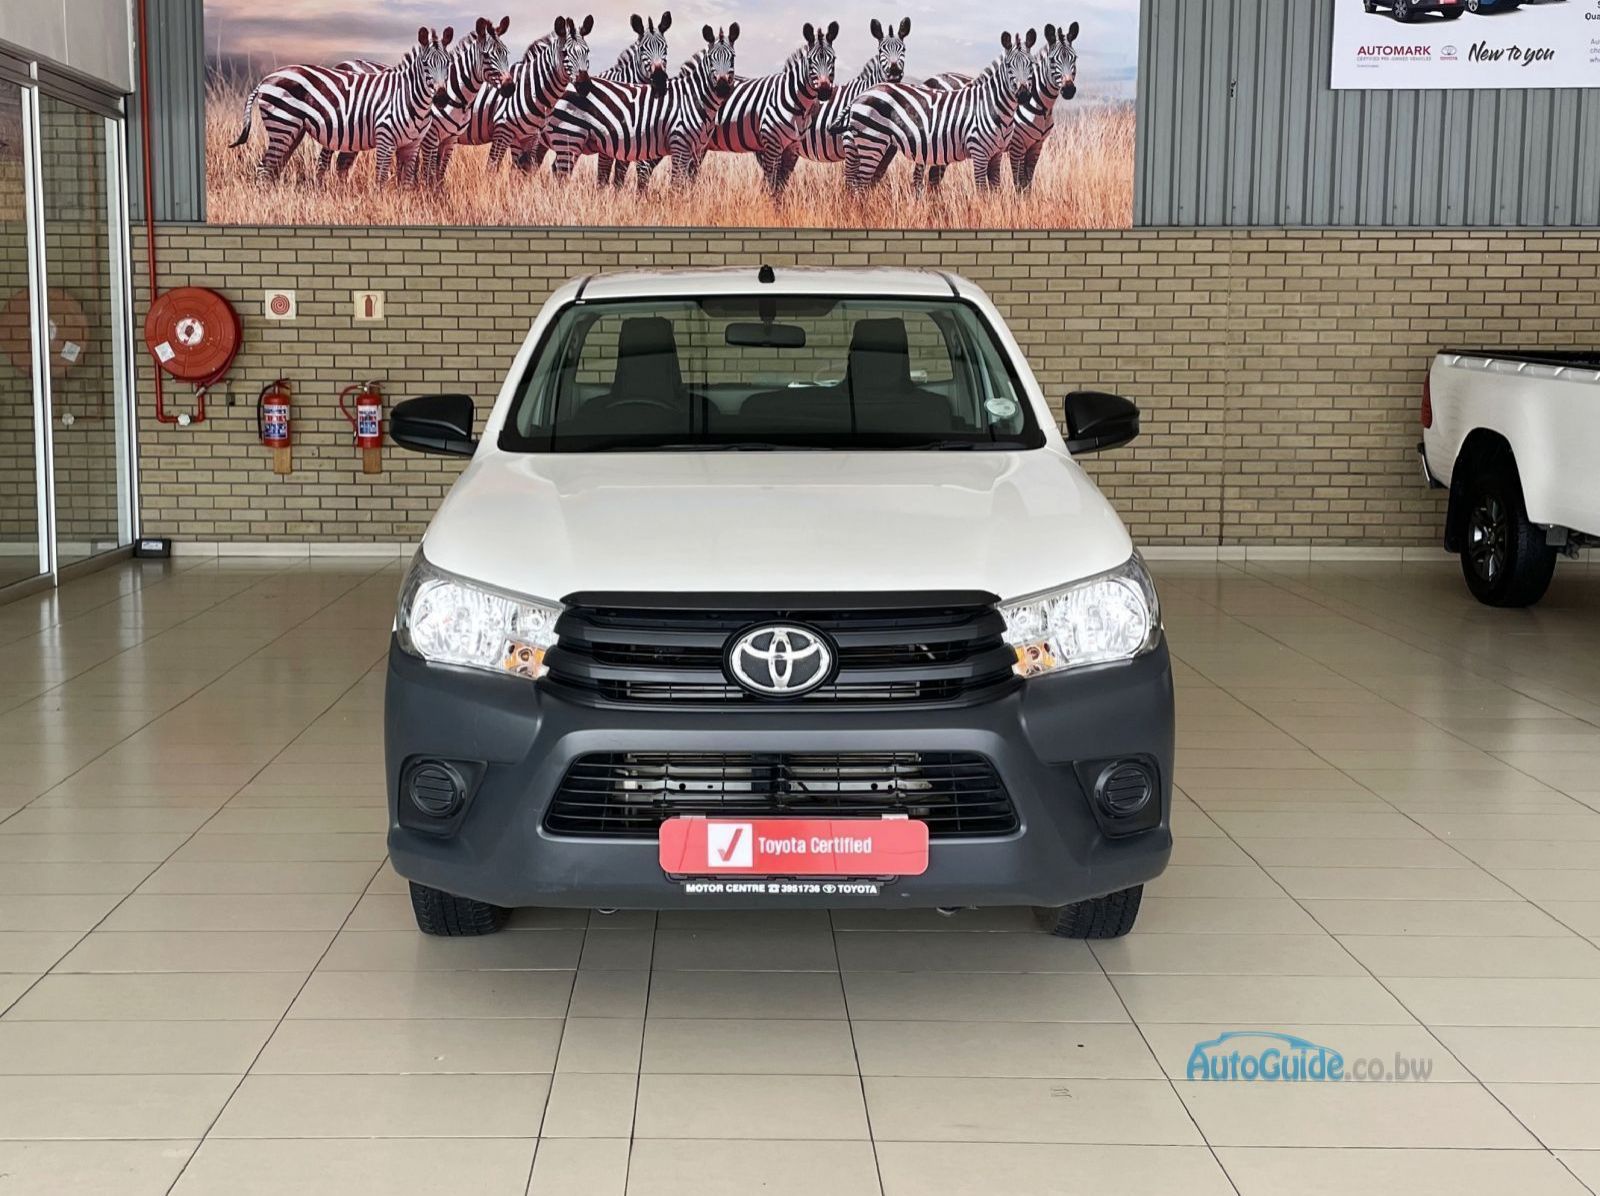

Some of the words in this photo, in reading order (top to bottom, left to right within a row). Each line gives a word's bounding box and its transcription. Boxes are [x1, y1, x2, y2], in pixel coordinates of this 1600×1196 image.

[1357, 45, 1431, 56] AUTOMARK
[1468, 40, 1504, 62] New
[1521, 47, 1555, 67] you
[759, 837, 806, 856] Toyota
[810, 836, 872, 854] Certified
[685, 883, 724, 894] MOTOR
[725, 883, 765, 894] CENTRE
[838, 884, 877, 894] TOYOTA
